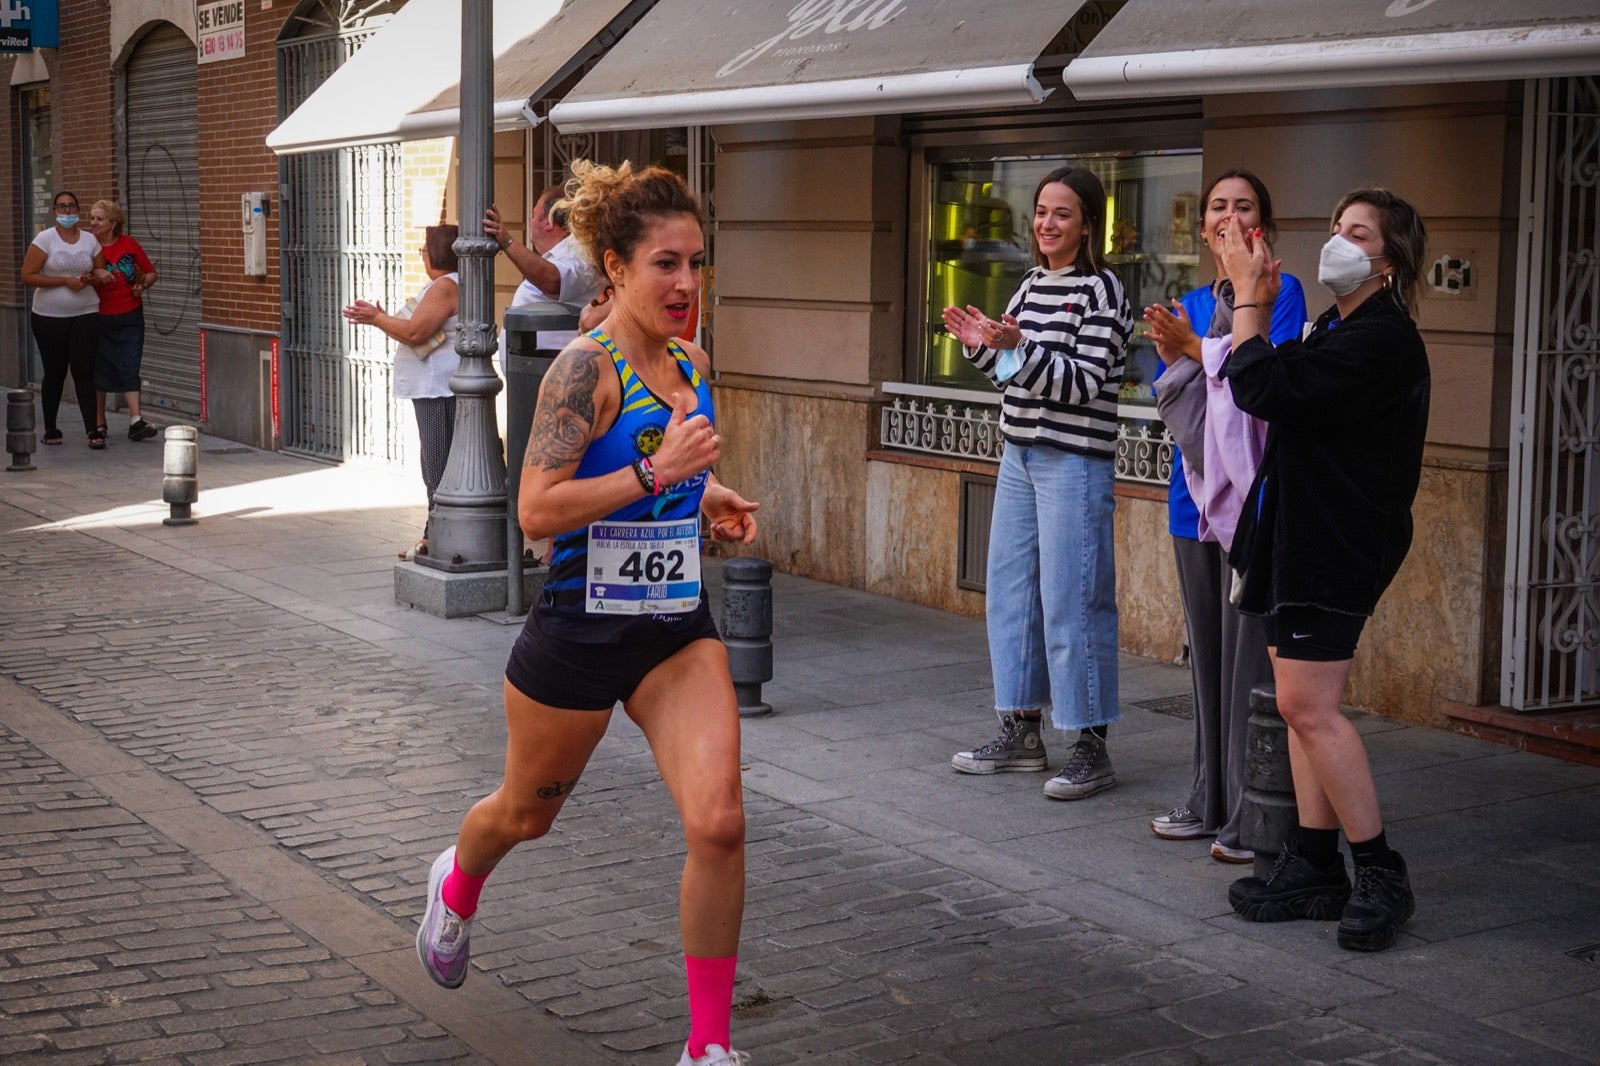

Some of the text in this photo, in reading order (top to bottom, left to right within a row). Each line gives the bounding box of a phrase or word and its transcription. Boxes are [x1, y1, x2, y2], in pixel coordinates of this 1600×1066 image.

[199, 1, 243, 30] SE VENDE
[610, 527, 638, 538] CARRERA
[640, 527, 655, 538] AZUL
[619, 549, 684, 582] 462
